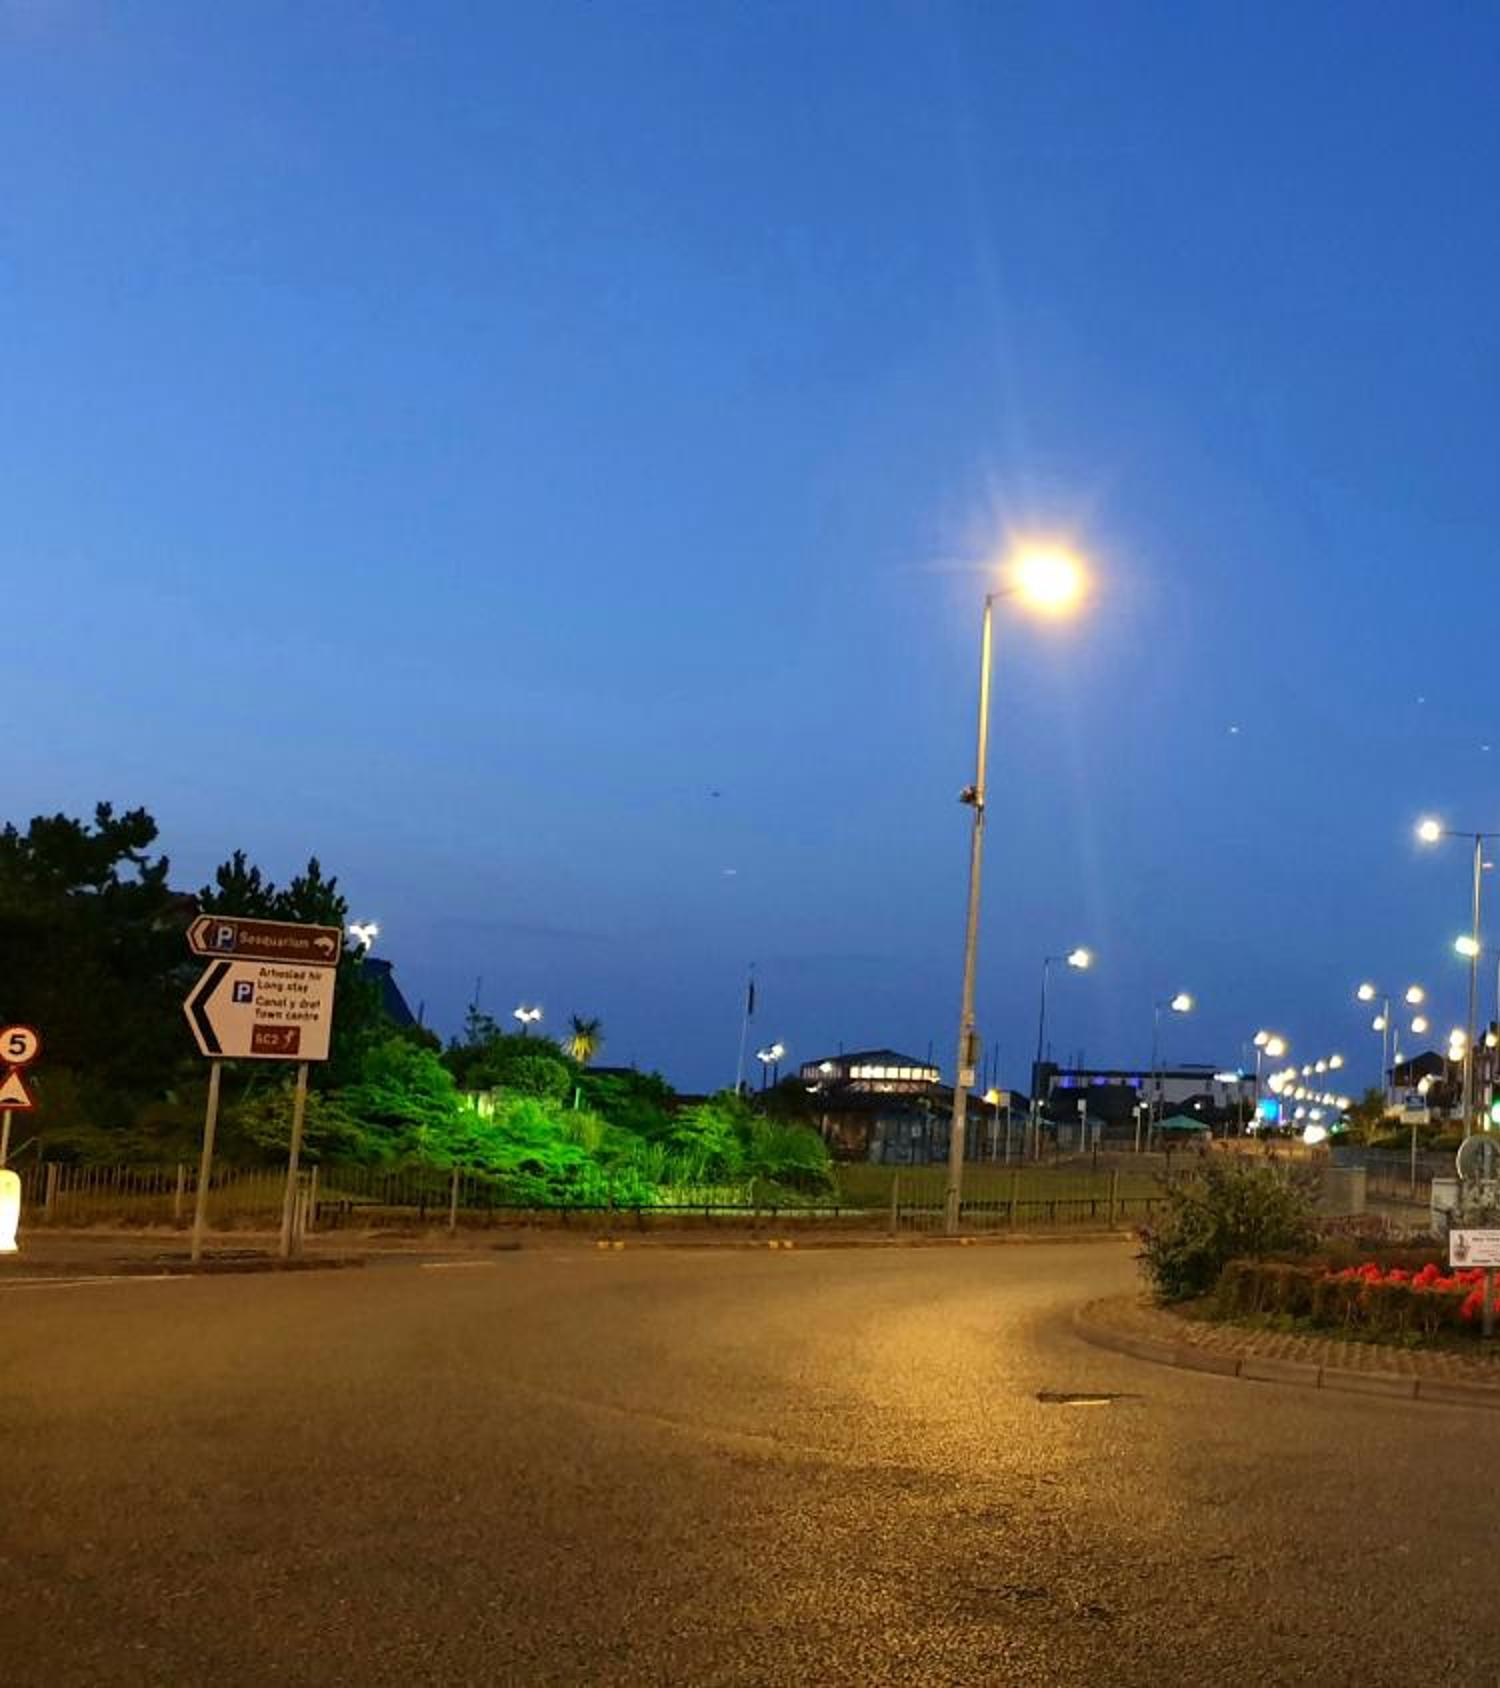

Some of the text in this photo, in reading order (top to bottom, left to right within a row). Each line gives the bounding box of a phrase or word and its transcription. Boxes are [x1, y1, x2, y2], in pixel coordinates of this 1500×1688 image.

[217, 926, 233, 947] P
[236, 983, 251, 1001] P
[257, 980, 308, 994] Long stay
[255, 1008, 319, 1022] Town centre
[8, 1034, 27, 1055] 5
